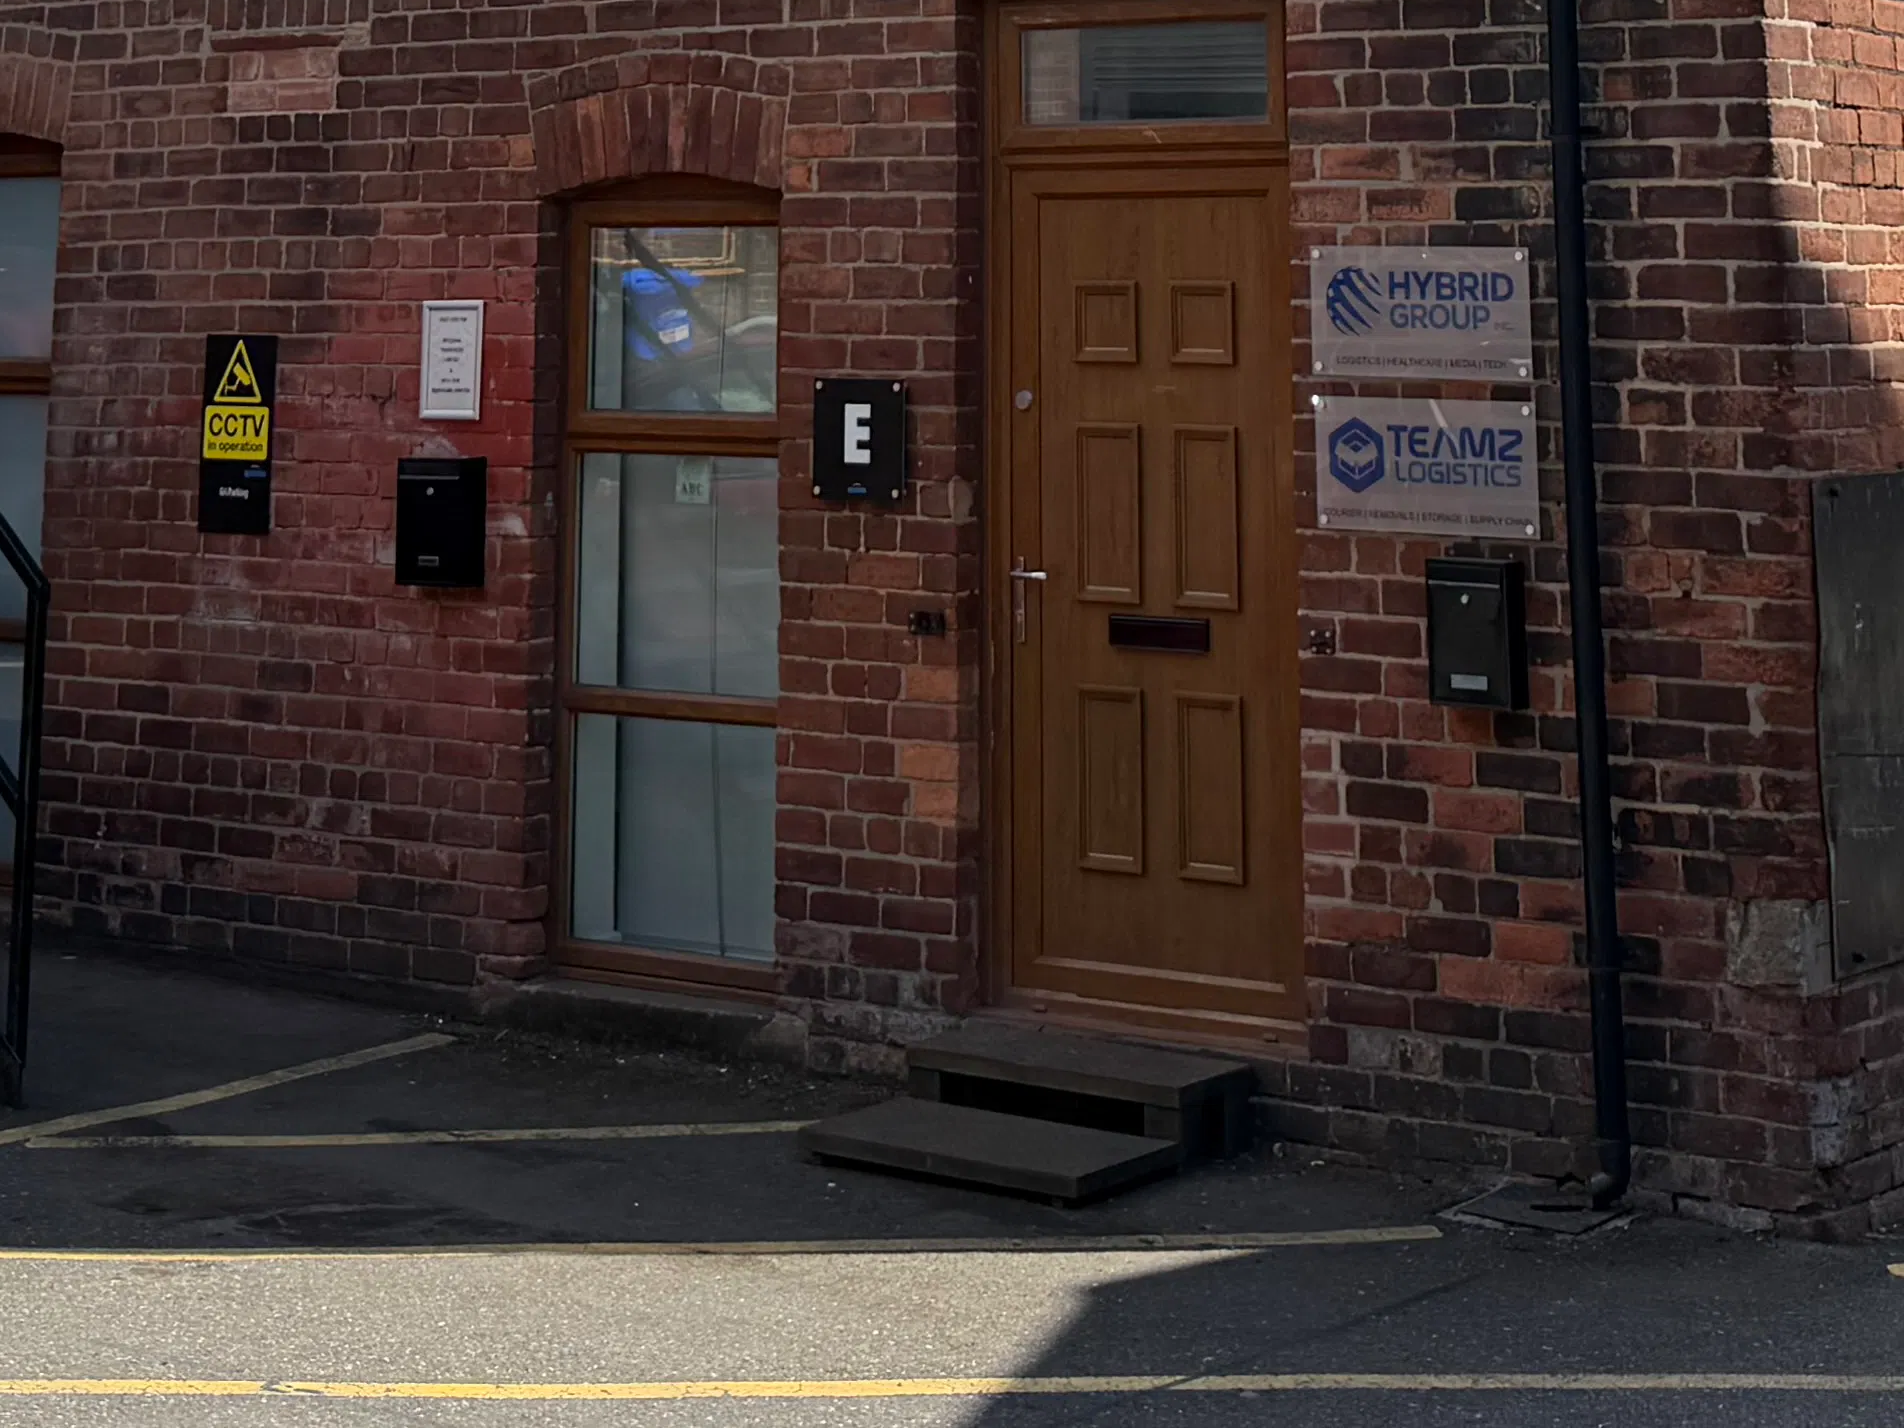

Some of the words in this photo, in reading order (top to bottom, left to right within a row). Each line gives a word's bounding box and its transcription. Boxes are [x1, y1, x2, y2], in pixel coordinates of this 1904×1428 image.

[1388, 271, 1514, 302] HYBRID
[1389, 303, 1490, 330] GROUP
[1336, 355, 1382, 366] LOGISTICS
[1386, 356, 1443, 368] HEALTHCARE
[1449, 358, 1477, 369] MEDIA
[209, 413, 265, 437] CCTV
[844, 403, 871, 464] E
[208, 440, 217, 450] in
[219, 442, 264, 453] operation
[1395, 460, 1522, 487] LOGISTICS
